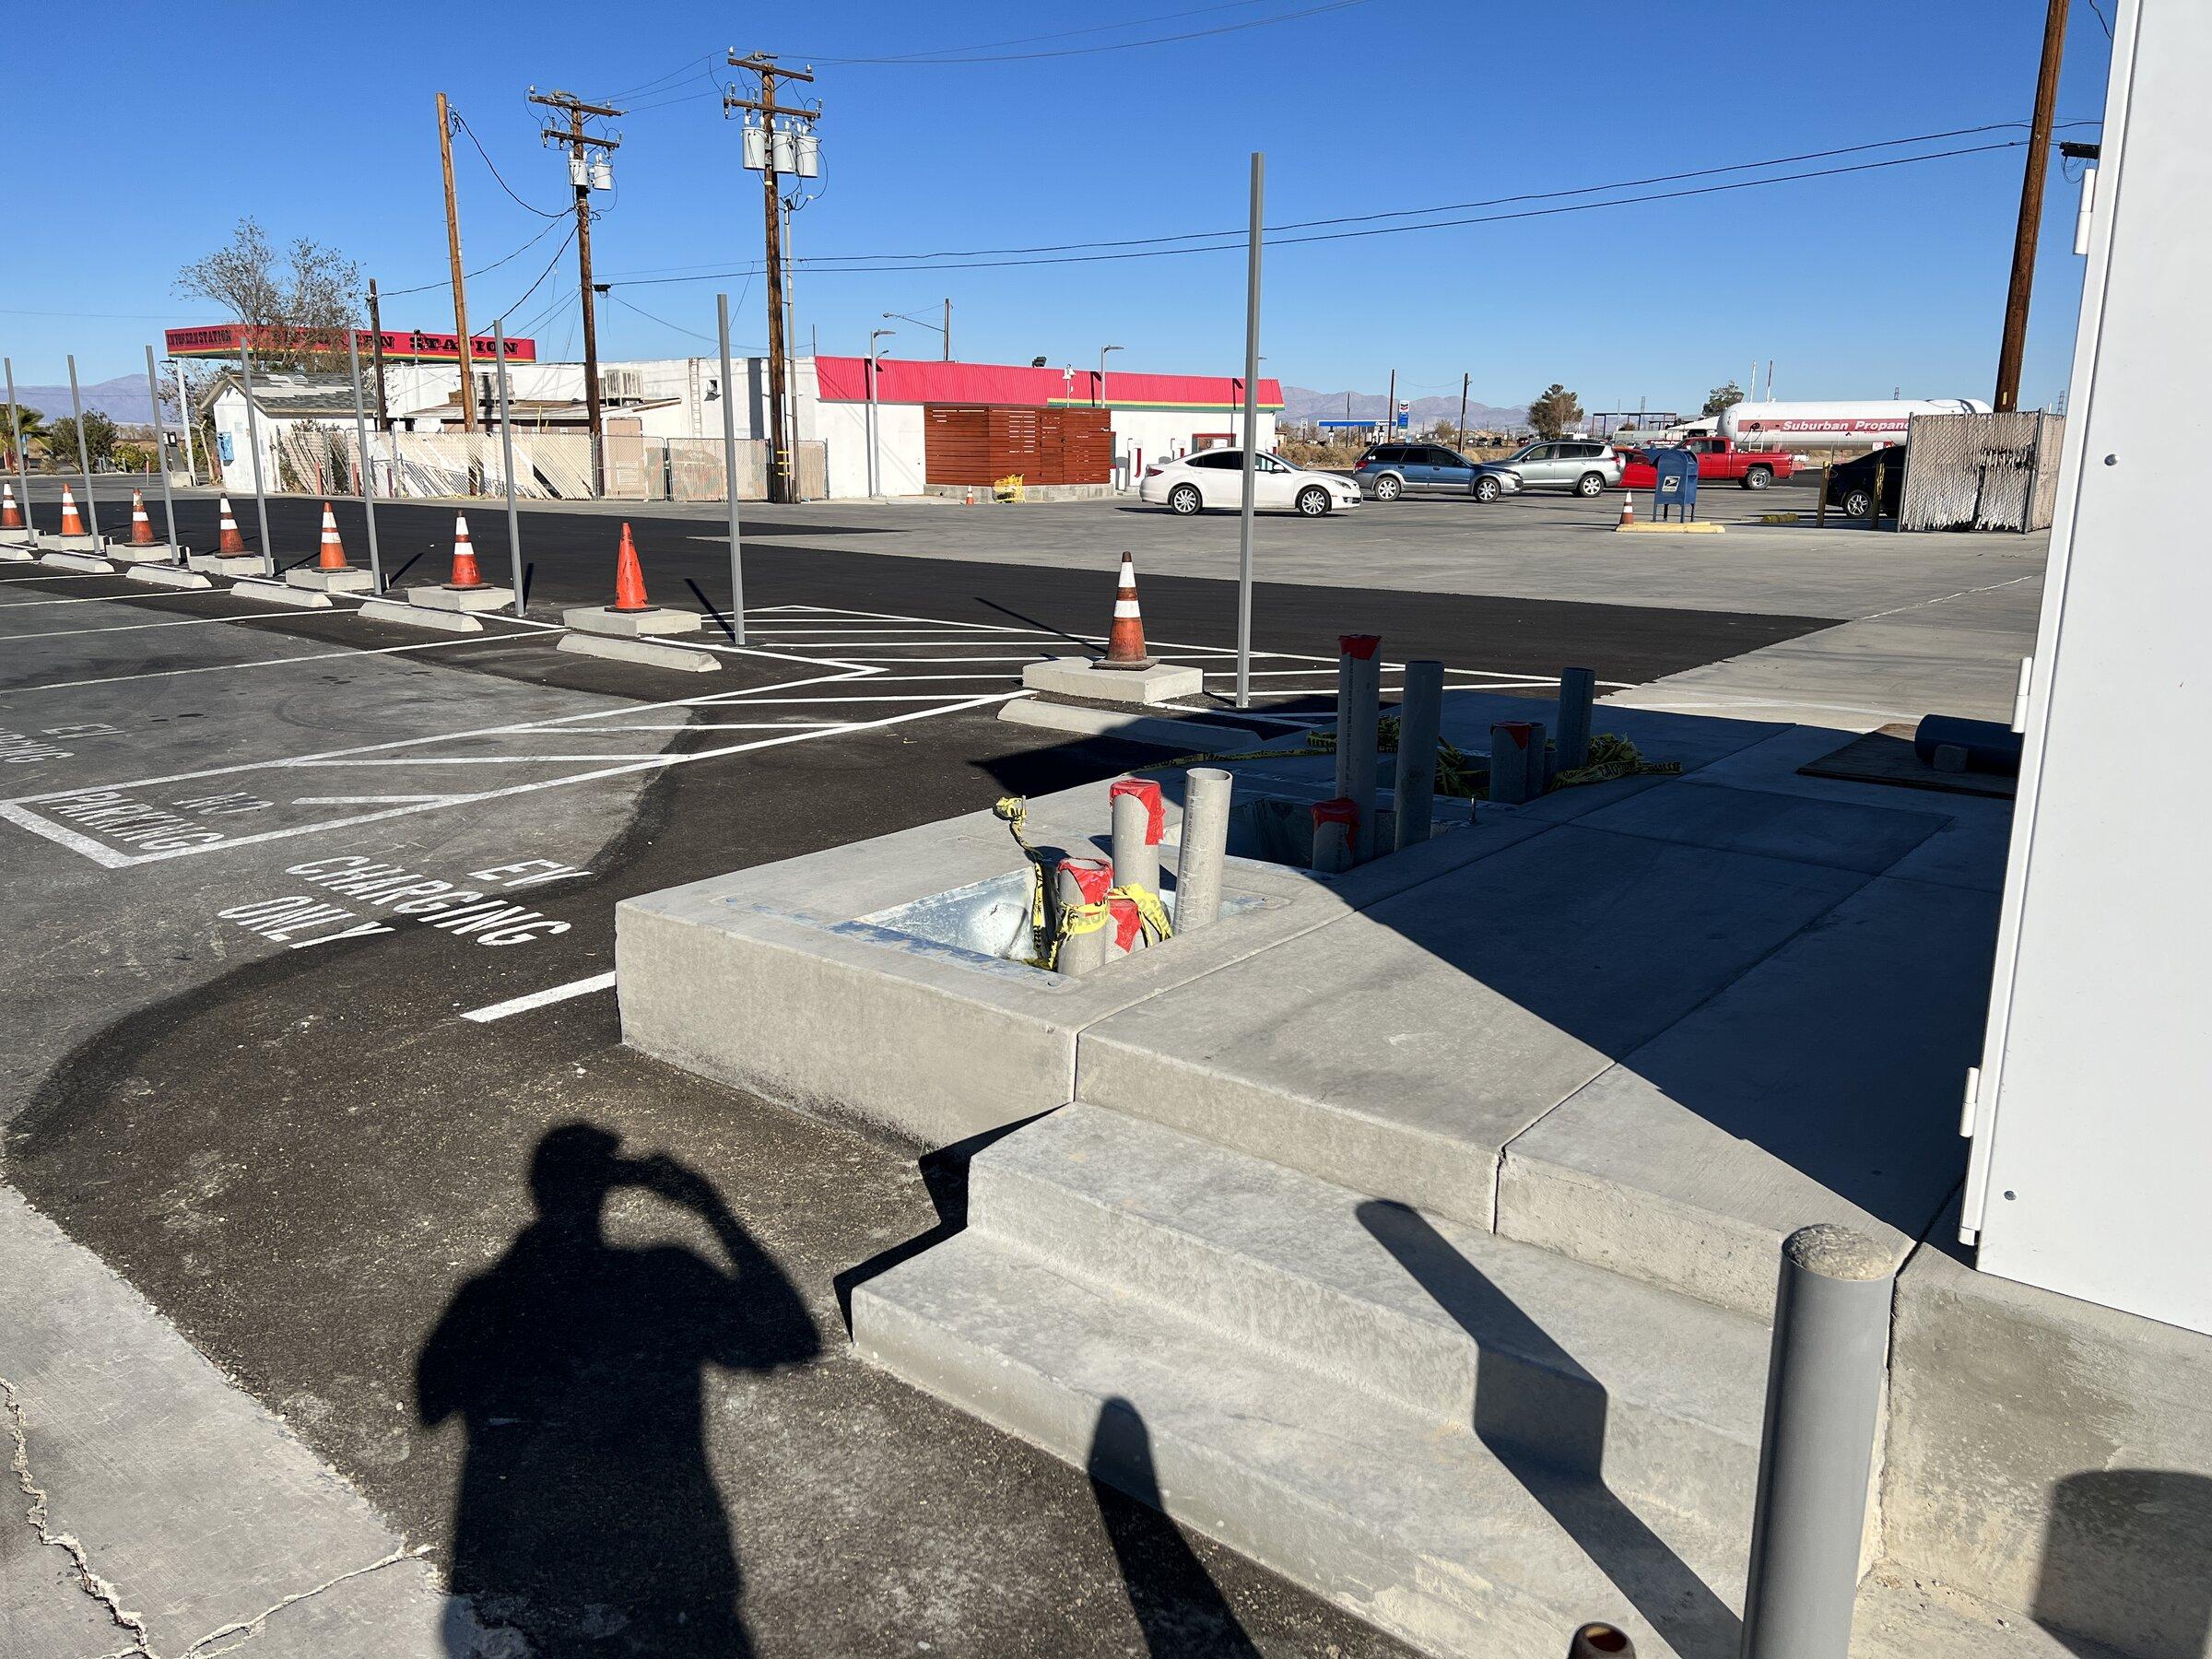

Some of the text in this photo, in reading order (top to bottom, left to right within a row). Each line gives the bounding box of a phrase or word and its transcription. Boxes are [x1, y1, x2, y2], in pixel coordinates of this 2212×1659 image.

[409, 335, 518, 355] STAION
[1783, 420, 1848, 430] Suburban
[171, 792, 275, 816] NO
[37, 792, 225, 850] PARKING
[466, 858, 594, 888] EV
[285, 855, 572, 946] CHARGING
[218, 895, 396, 949] ONLY
